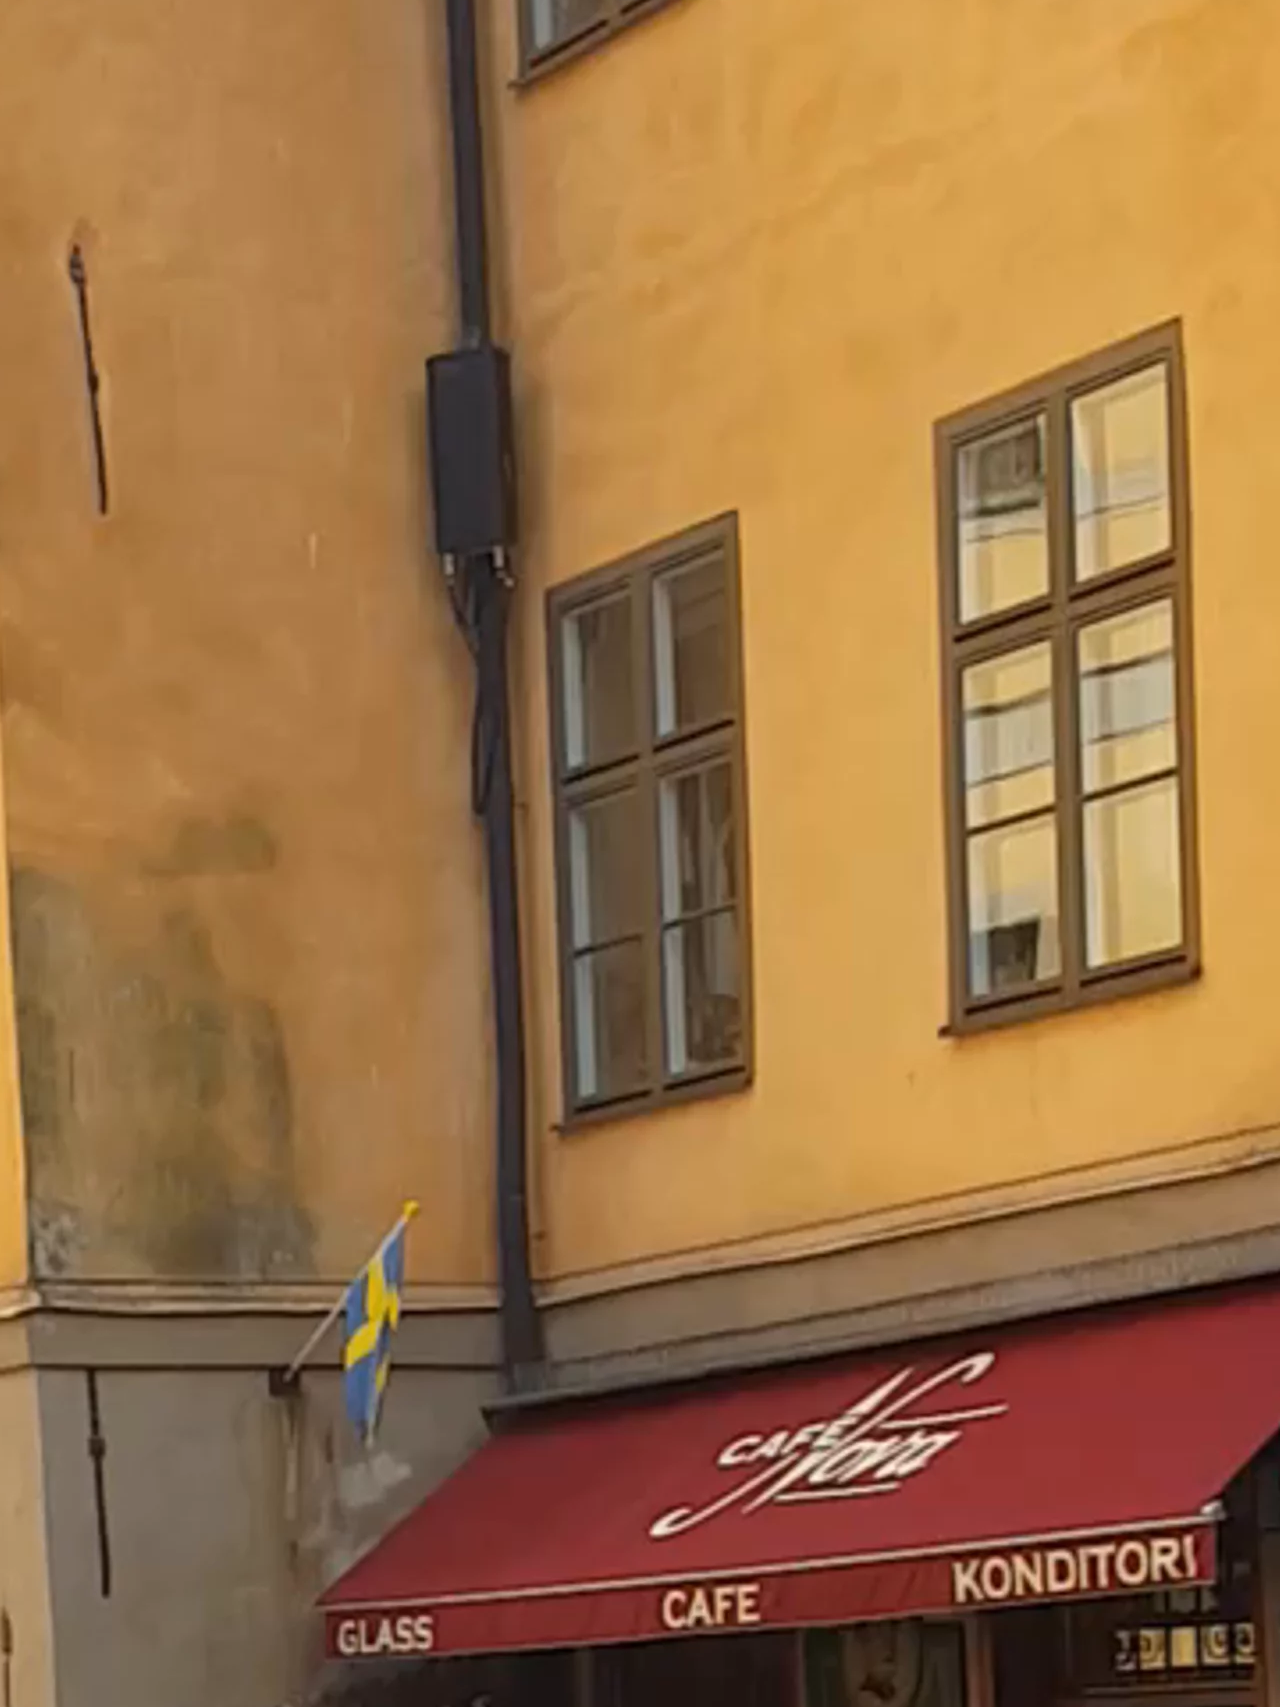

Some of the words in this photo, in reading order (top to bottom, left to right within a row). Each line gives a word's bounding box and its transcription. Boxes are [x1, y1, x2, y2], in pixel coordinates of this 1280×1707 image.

[650, 1352, 998, 1539] Nova
[952, 1537, 1198, 1604] KONDITORI
[337, 1613, 434, 1656] GLASS
[662, 1583, 761, 1631] CAFE
